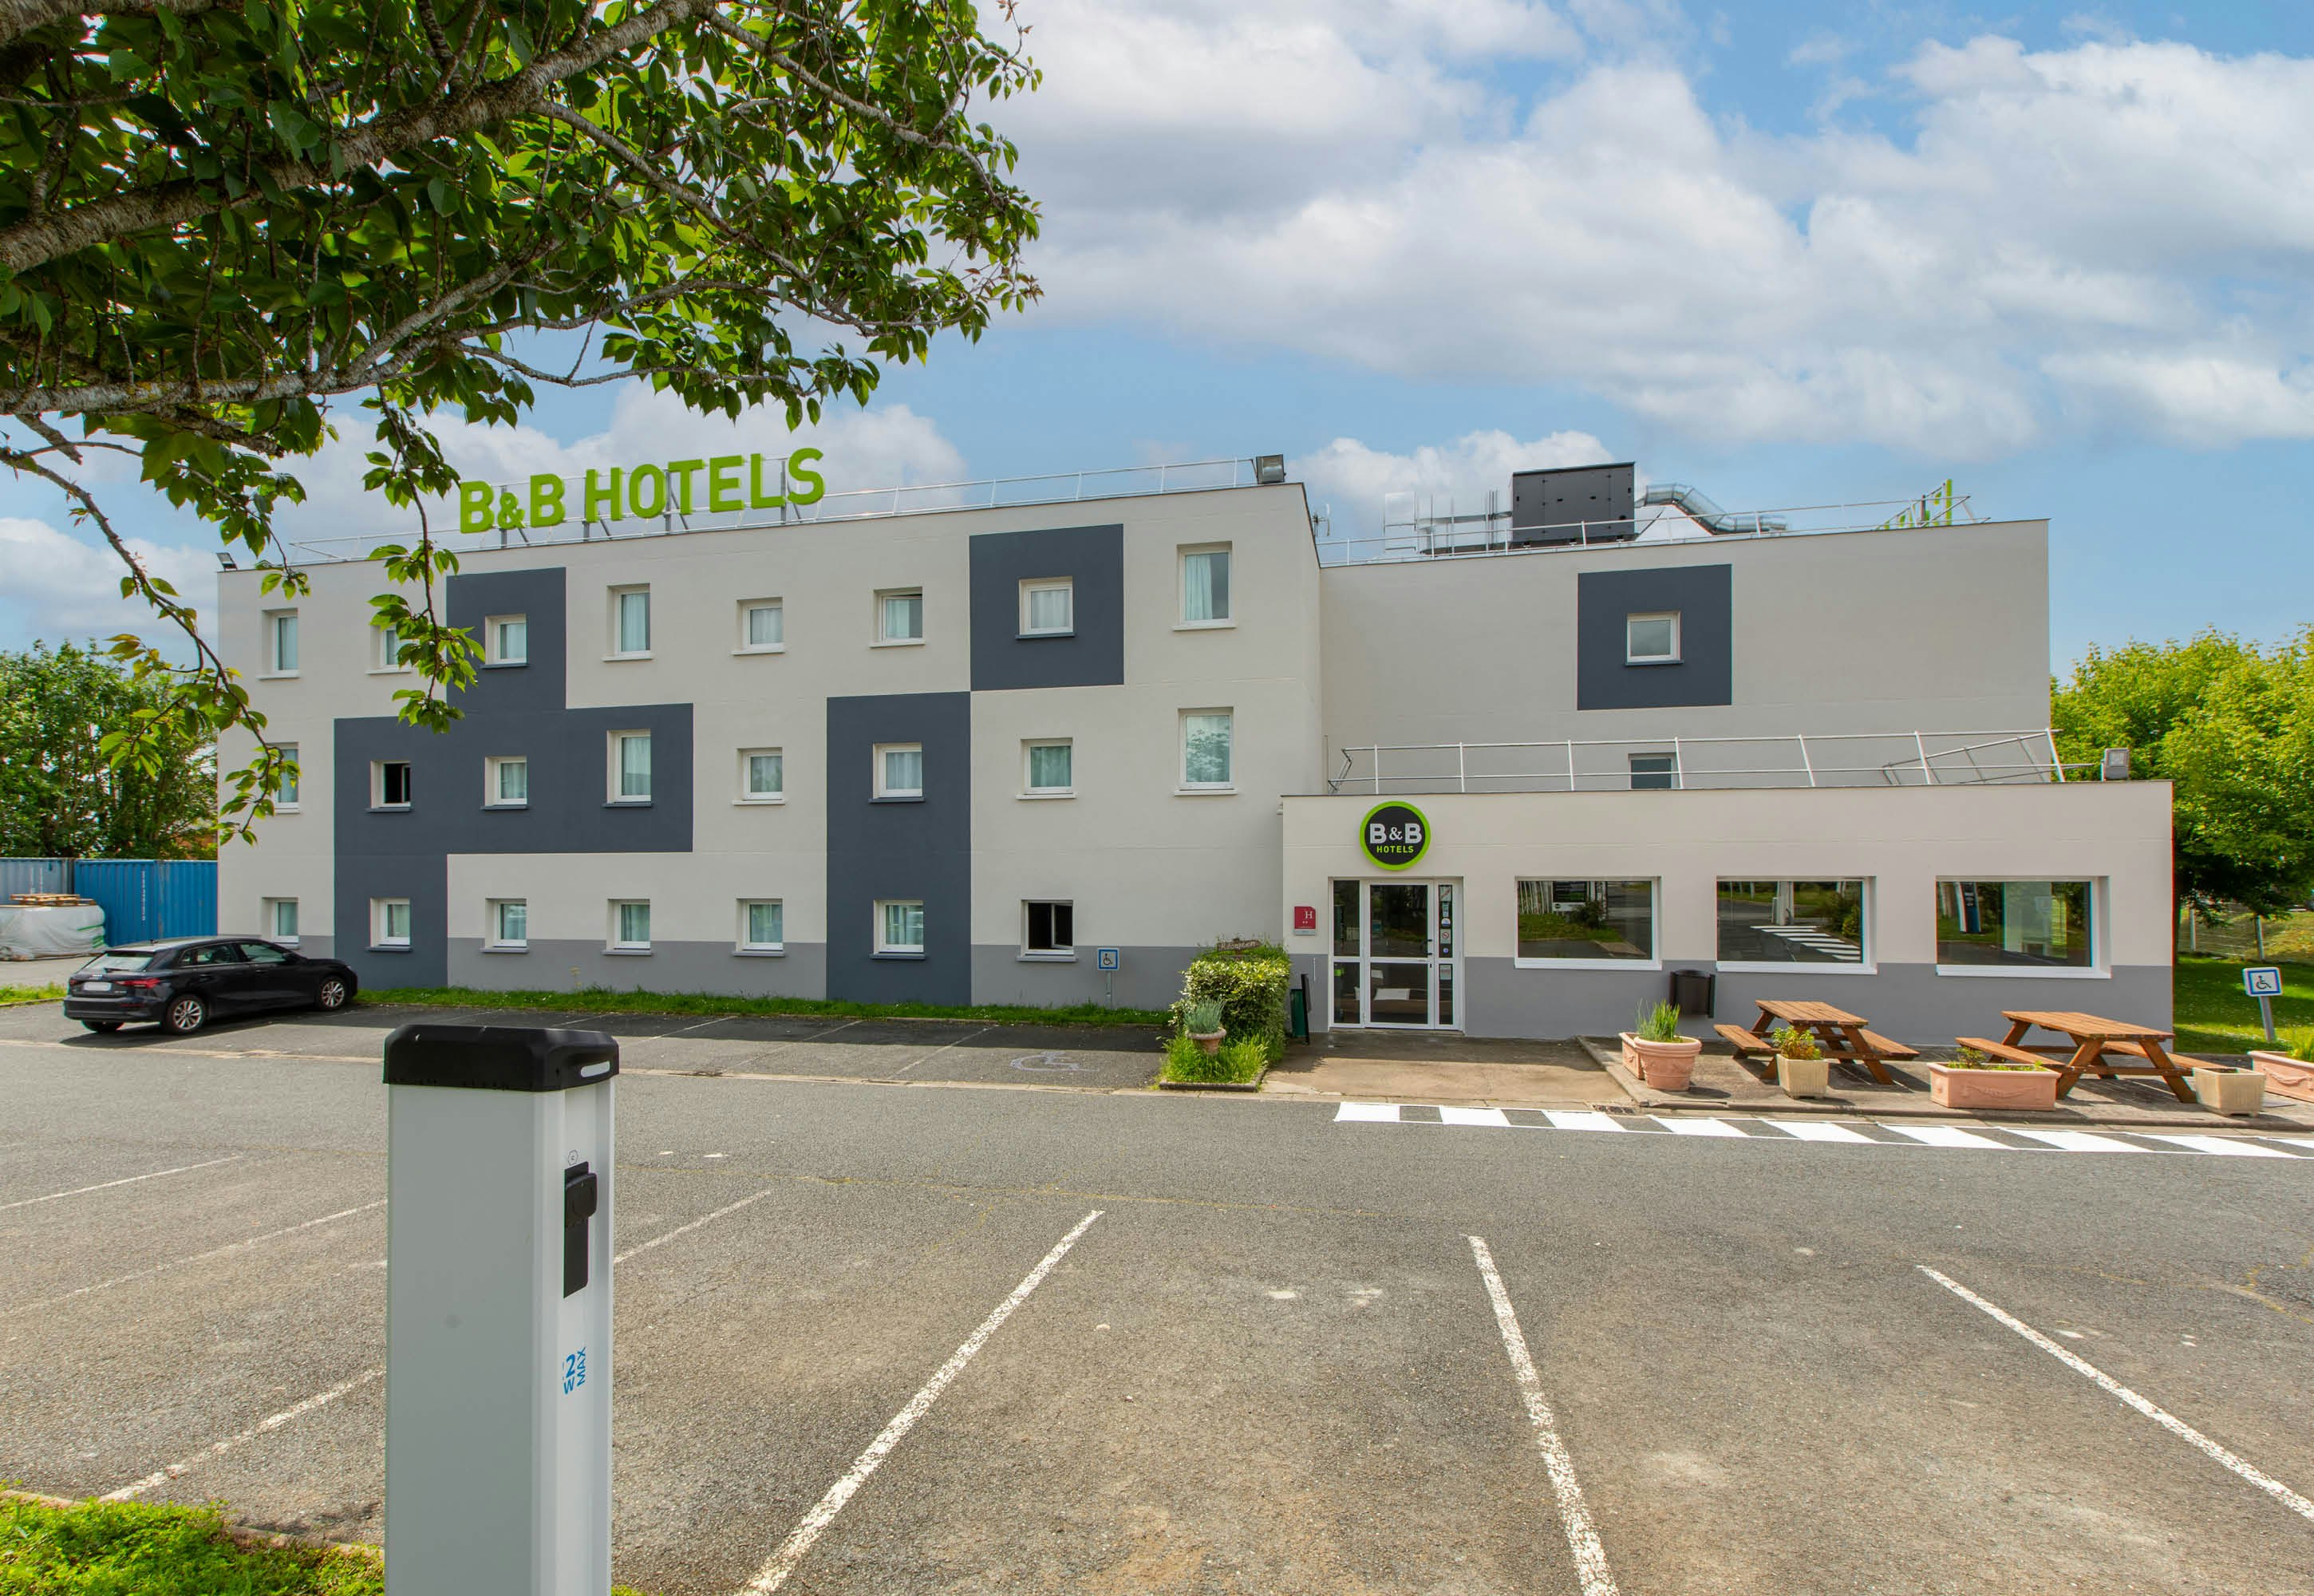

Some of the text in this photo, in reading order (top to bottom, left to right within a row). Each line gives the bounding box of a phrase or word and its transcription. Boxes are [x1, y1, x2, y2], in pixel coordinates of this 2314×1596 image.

[460, 448, 825, 534] B&B HOTELS
[1369, 823, 1423, 843] B&B
[1305, 911, 1313, 919] H
[577, 1347, 586, 1386] MAX
